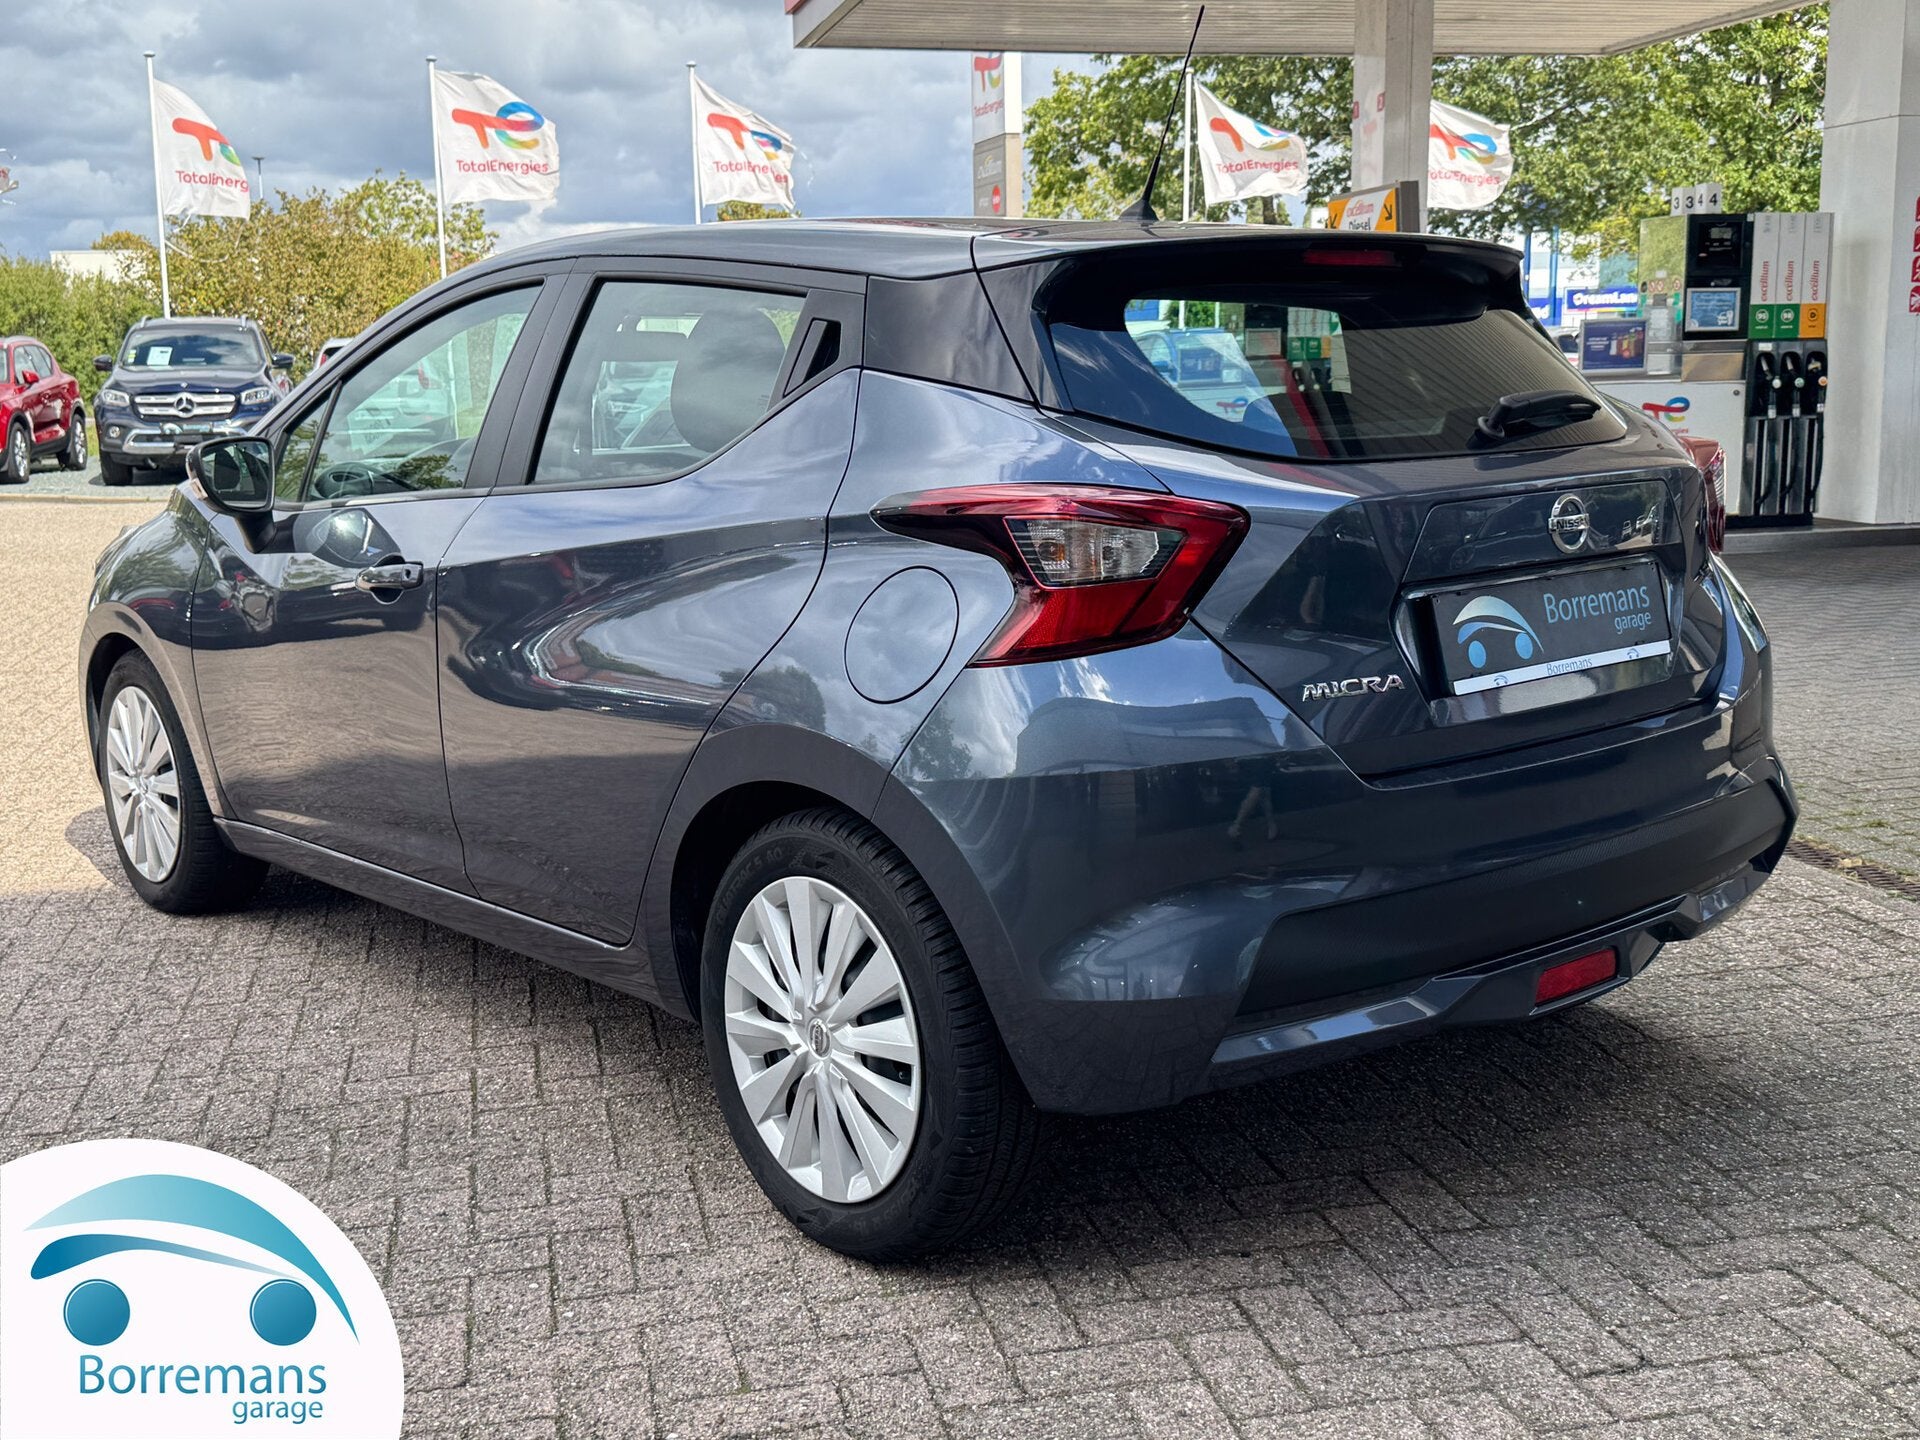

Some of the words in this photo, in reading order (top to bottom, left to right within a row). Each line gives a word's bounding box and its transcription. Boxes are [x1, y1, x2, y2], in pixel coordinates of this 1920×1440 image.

[456, 160, 549, 175] TotalEnergies
[1216, 160, 1299, 174] TotalEnergies
[1673, 196, 1680, 210] 3
[1685, 195, 1694, 209] 3
[1697, 193, 1704, 207] 4
[1708, 192, 1718, 207] 4
[1572, 291, 1638, 306] DreamLan
[1543, 586, 1650, 624] Borremans
[1614, 611, 1652, 635] garage
[1546, 657, 1593, 676] Borremans
[1302, 674, 1406, 702] MICRA
